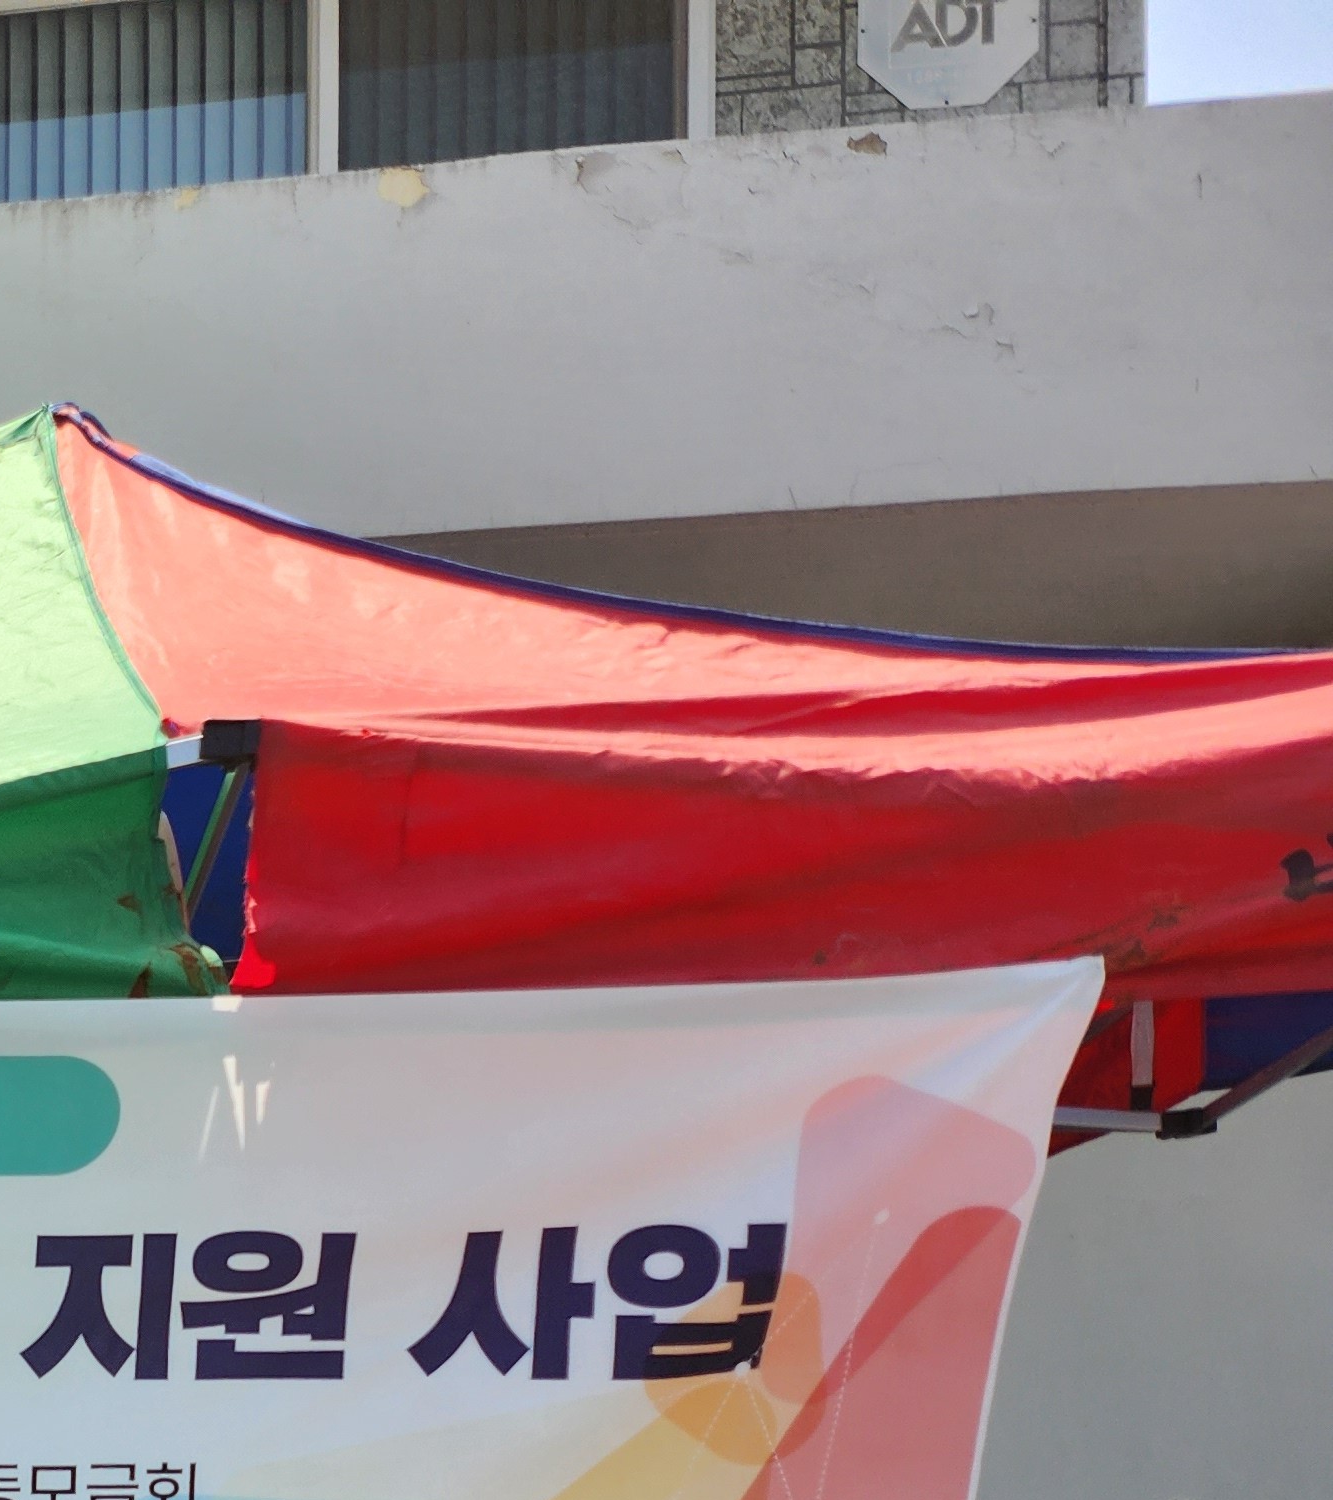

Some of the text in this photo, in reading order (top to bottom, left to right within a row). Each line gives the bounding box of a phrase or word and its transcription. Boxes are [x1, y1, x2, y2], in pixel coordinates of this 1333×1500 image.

[890, 0, 1005, 52] ADT
[19, 1225, 357, 1380] 지원
[407, 1222, 789, 1381] 사업
